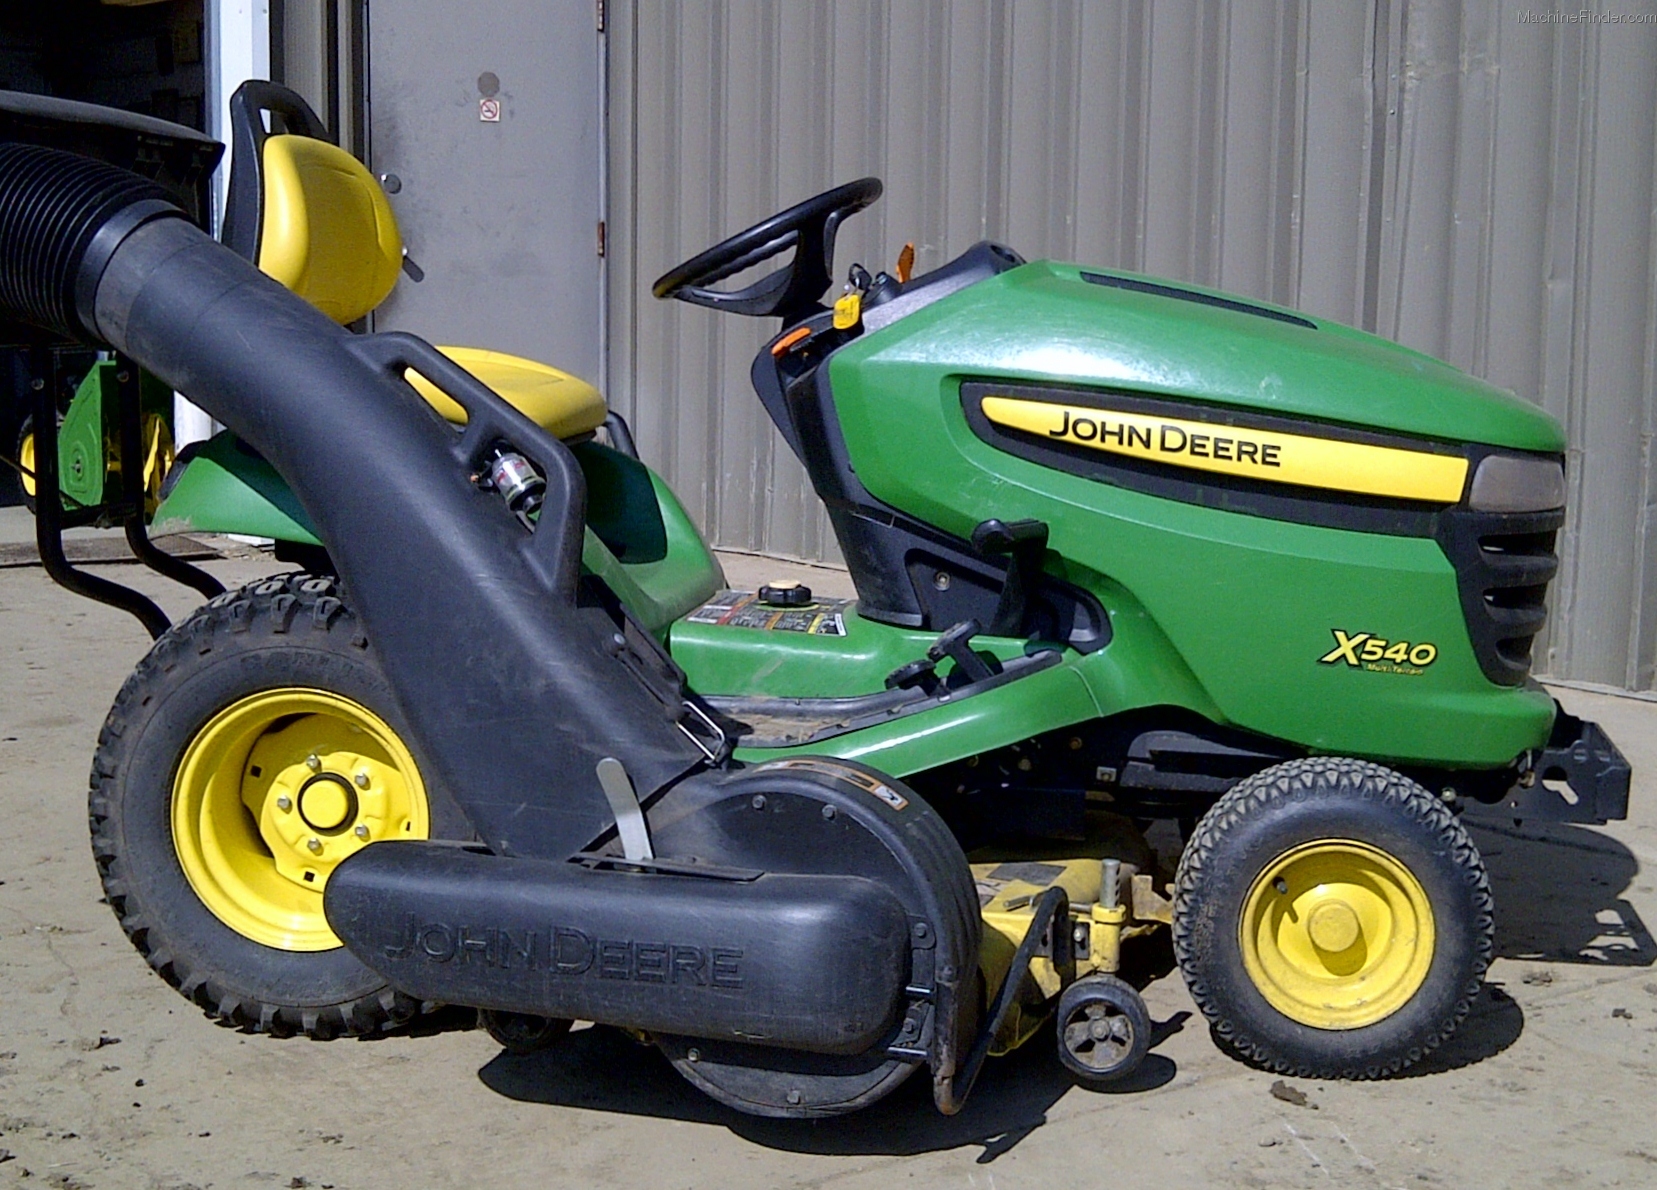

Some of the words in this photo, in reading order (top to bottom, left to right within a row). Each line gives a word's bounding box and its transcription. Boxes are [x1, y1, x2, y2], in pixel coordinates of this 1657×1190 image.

[1049, 411, 1151, 450] JOHN
[1160, 424, 1281, 468] DEERE
[1317, 628, 1438, 668] X540
[384, 911, 537, 972] JOHN
[550, 925, 744, 988] DEERE
